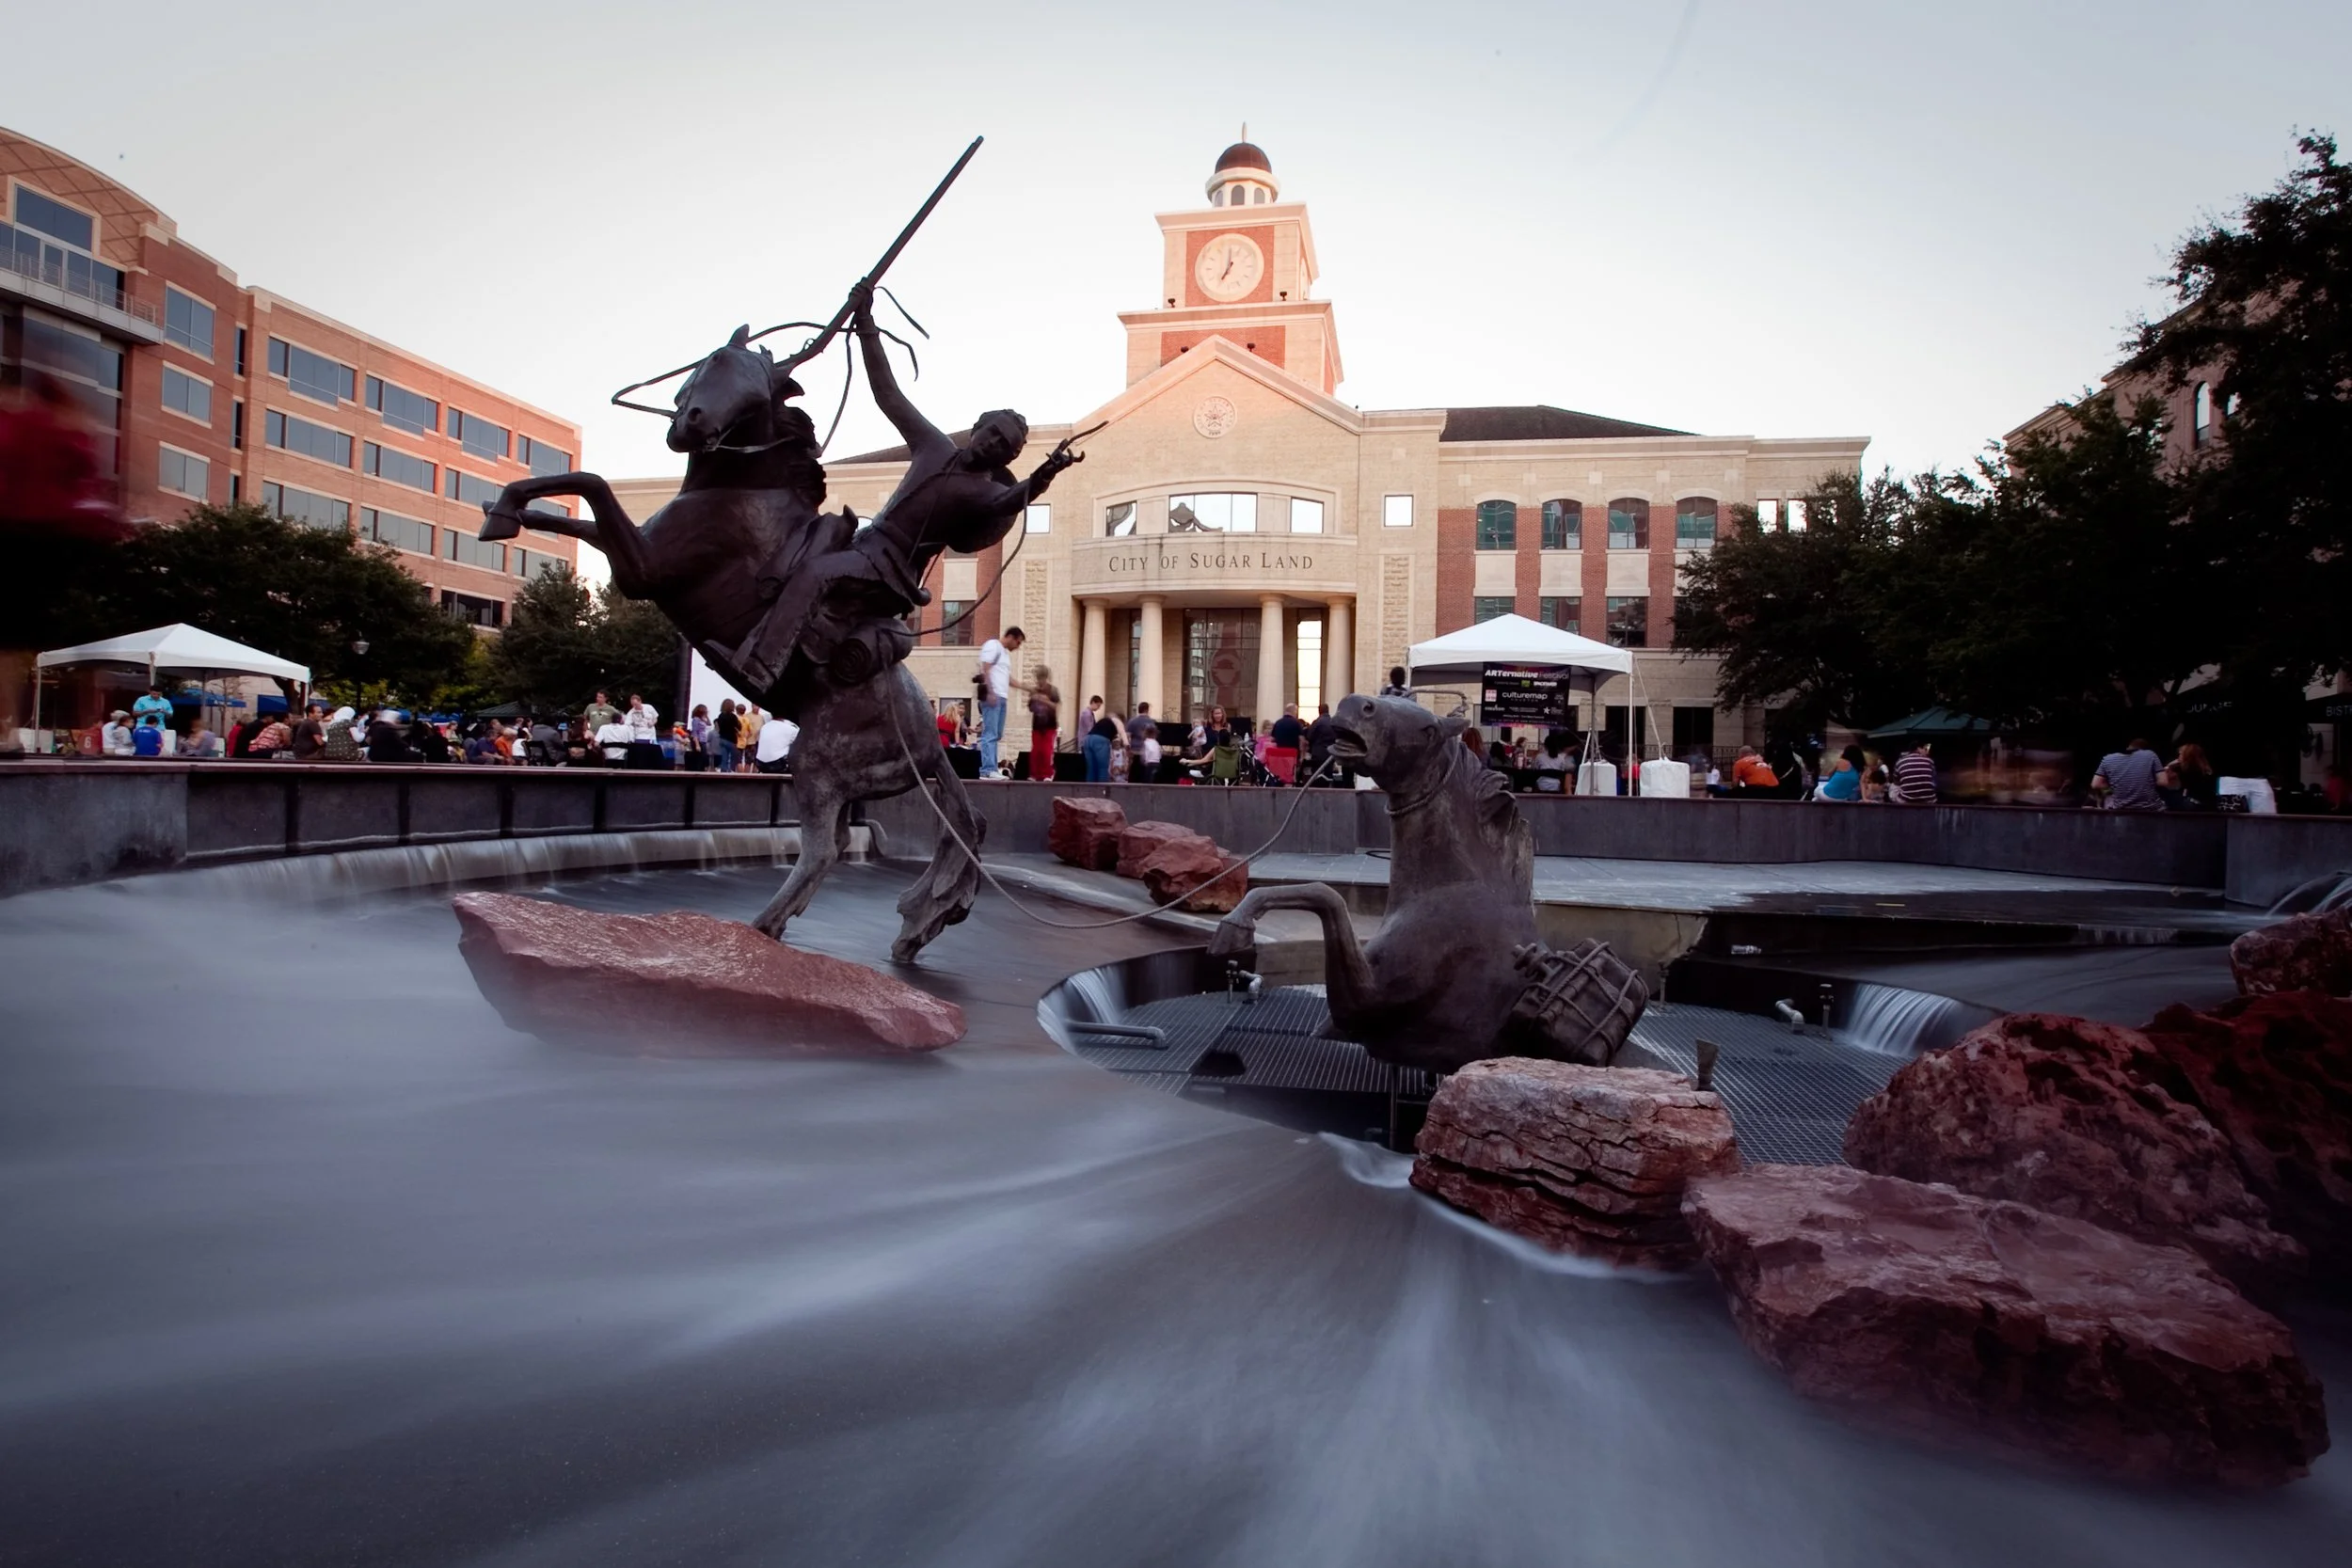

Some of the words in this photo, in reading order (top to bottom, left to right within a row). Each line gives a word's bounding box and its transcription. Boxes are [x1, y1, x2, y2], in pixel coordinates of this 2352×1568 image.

[1108, 556, 1148, 572] CITY
[1160, 555, 1179, 569] OF
[1189, 552, 1251, 569] SUGAR
[1261, 552, 1313, 570] LAND
[1485, 670, 1539, 678] ARTernative
[1502, 691, 1548, 700] culturemap
